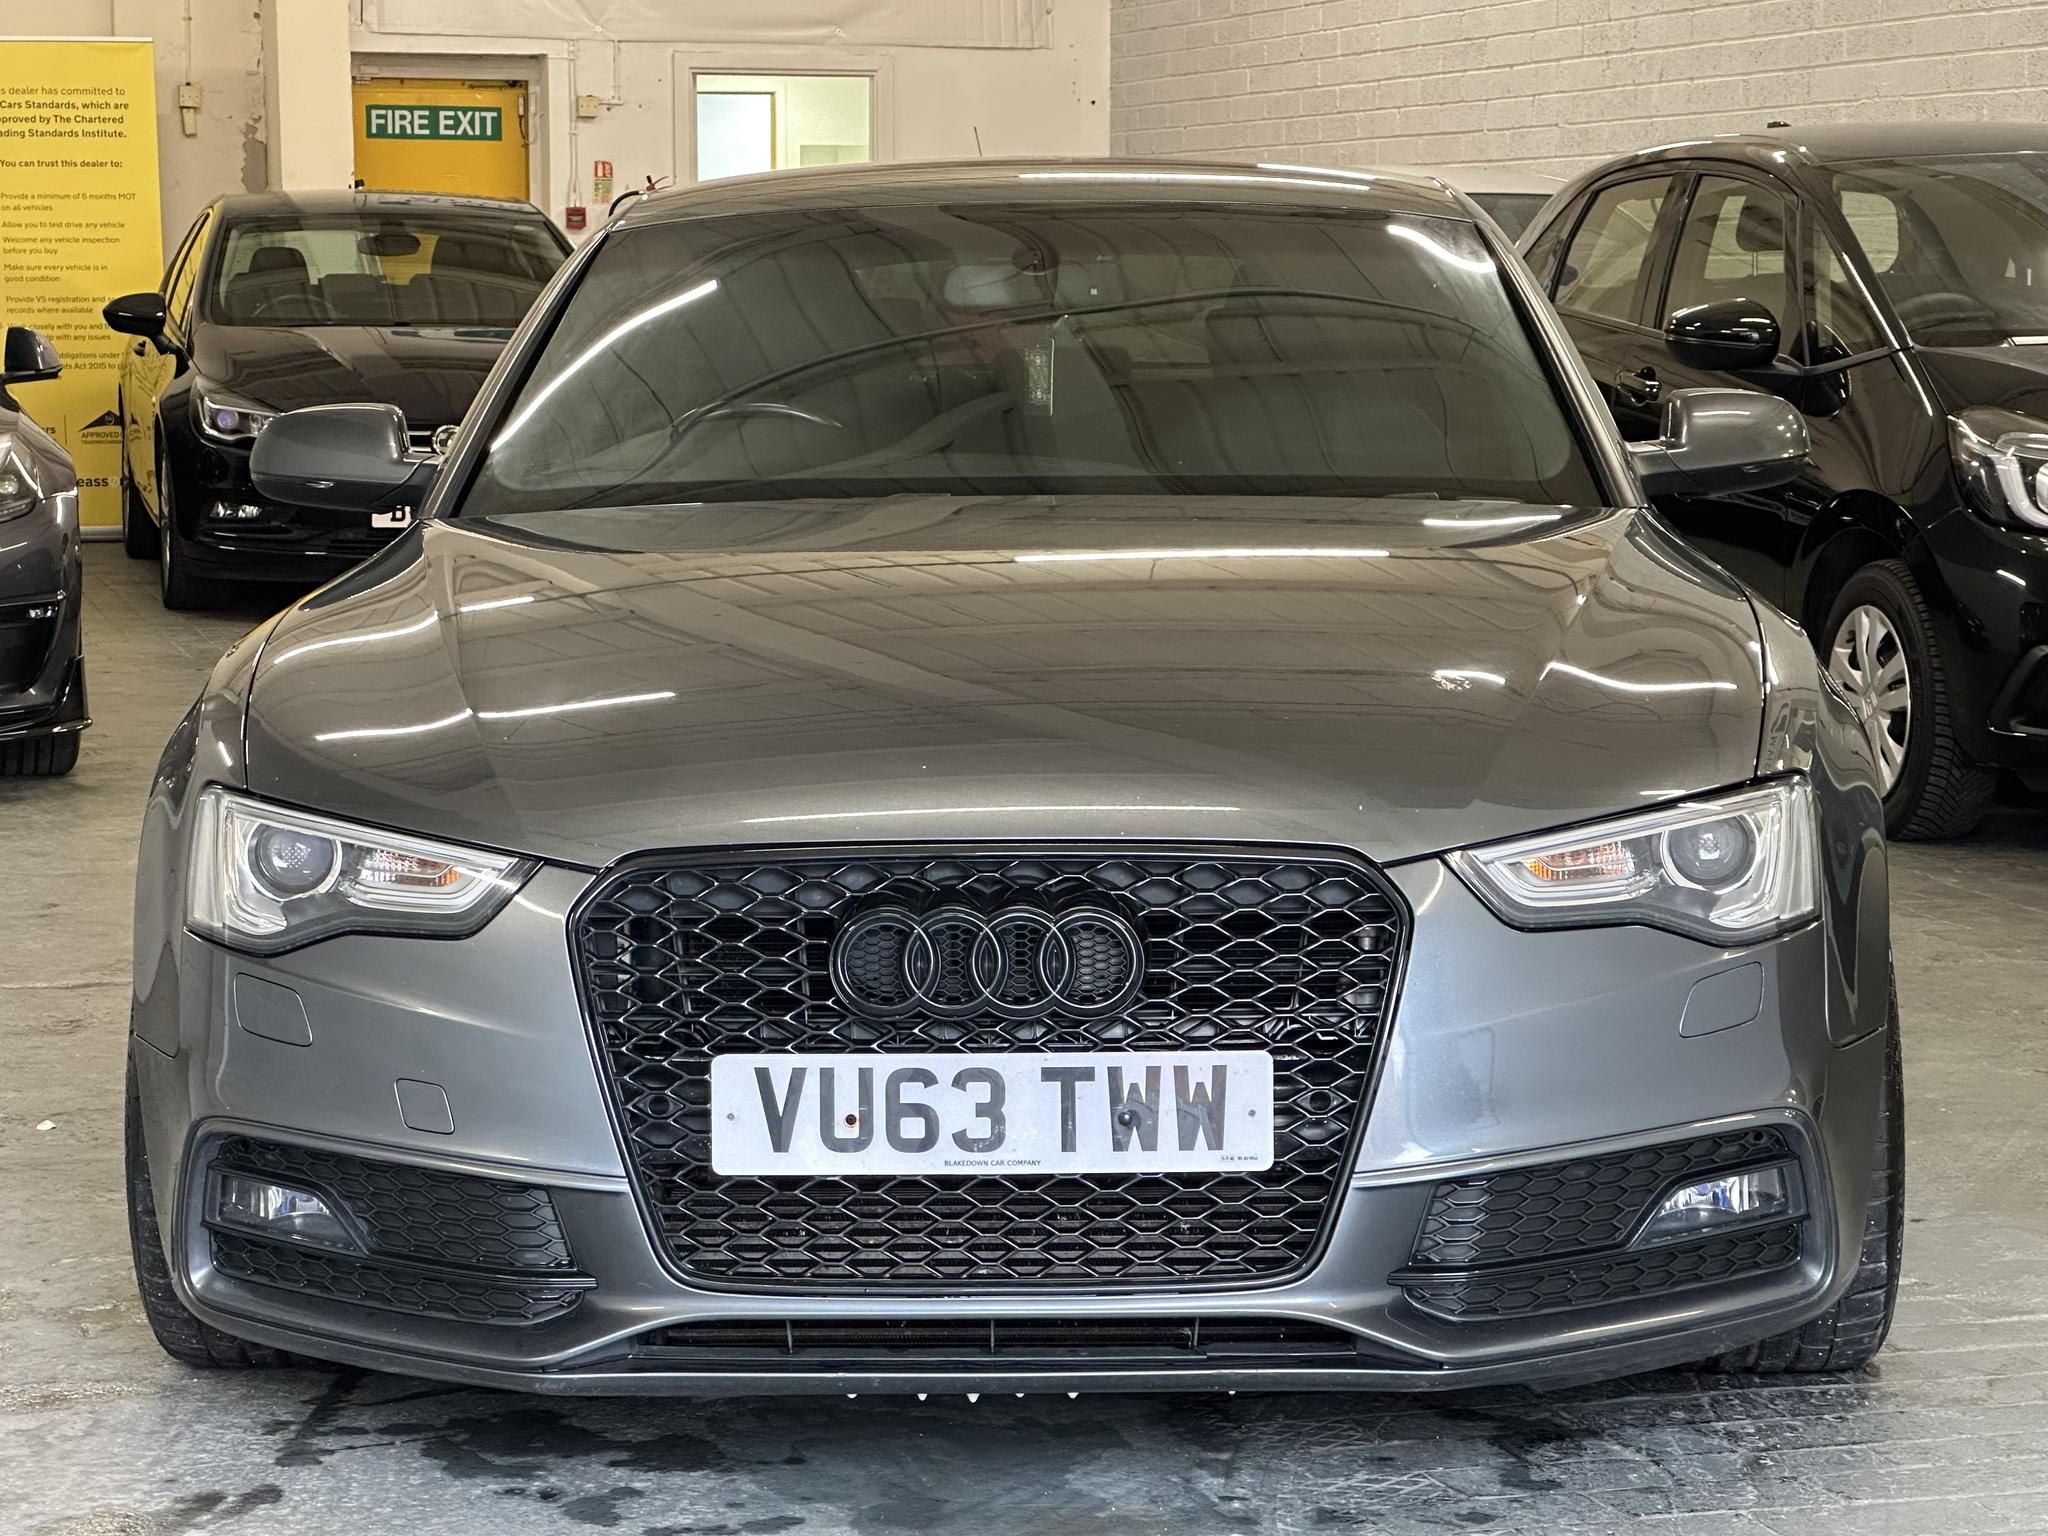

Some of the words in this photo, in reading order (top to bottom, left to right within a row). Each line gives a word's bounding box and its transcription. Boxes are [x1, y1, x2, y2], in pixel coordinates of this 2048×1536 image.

[9, 86, 38, 95] dealer
[42, 86, 57, 95] has
[61, 86, 112, 95] committed
[0, 100, 22, 109] Cars
[25, 100, 79, 110] Standards,
[81, 101, 111, 109] which
[0, 115, 36, 125] proved
[40, 115, 50, 125] by
[53, 115, 71, 123] The
[74, 115, 124, 124] Chartered
[370, 109, 430, 135] FIRE
[439, 110, 497, 136] EXIT
[28, 129, 79, 137] Standards
[82, 129, 126, 138] Institute.
[80, 160, 108, 168] dealer
[110, 160, 122, 168] to:
[1, 192, 29, 200] Provide
[82, 236, 120, 244] inspection
[4, 275, 24, 283] good
[48, 296, 89, 304] registration
[754, 1066, 1006, 1153] VU63
[1041, 1065, 1227, 1152] TWW
